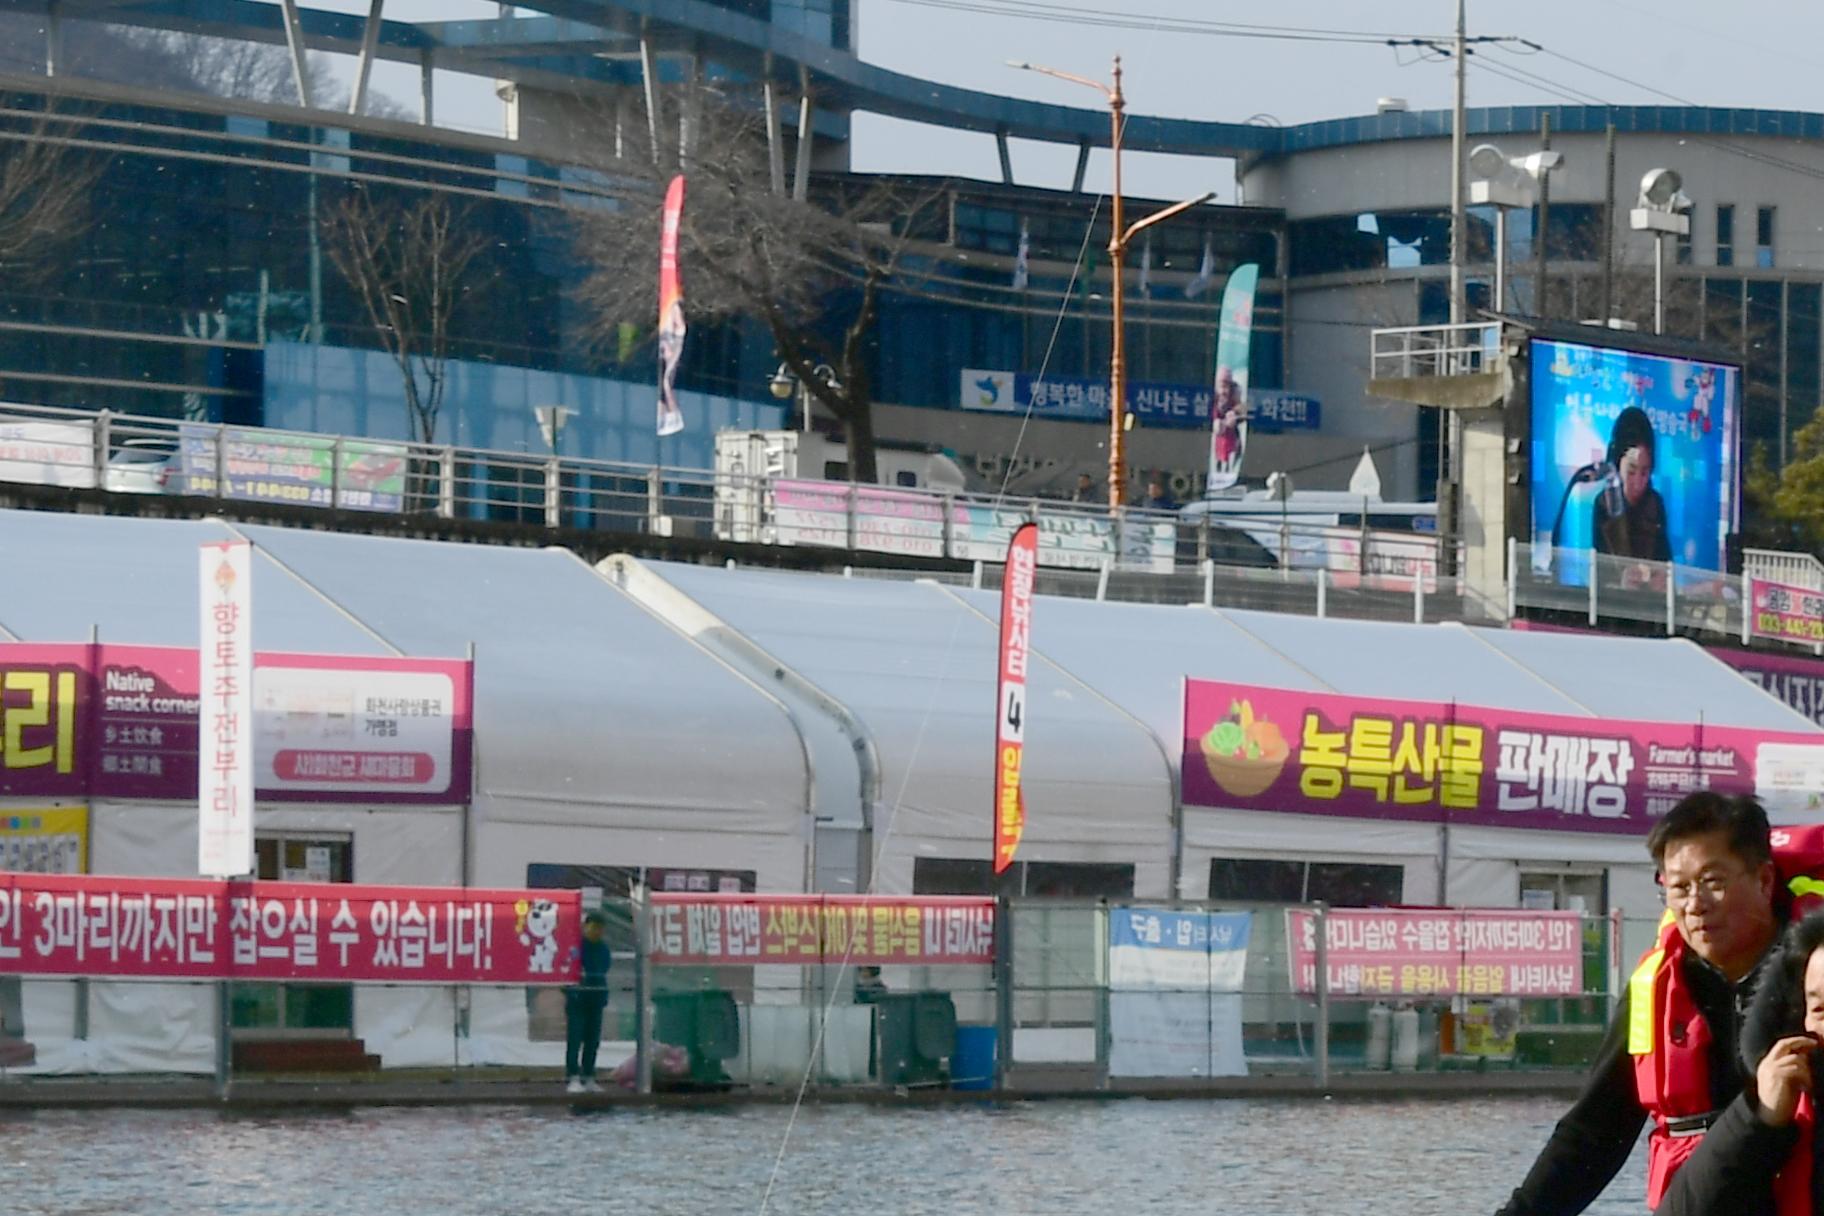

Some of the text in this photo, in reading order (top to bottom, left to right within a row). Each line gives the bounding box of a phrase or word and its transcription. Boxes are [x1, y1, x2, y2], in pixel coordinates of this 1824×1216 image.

[1030, 382, 1083, 407] 행복한
[1136, 389, 1188, 416] 신나는
[105, 669, 155, 692] Native
[0, 671, 76, 774] 리
[105, 694, 150, 712] snack
[211, 602, 240, 817] 향토주전부리
[1006, 692, 1022, 734] 4
[1299, 714, 1634, 818] 농특산물 판매장
[1648, 743, 1697, 765] Farmer's
[35, 889, 217, 964] 3마리까지만
[229, 896, 320, 968] 잡으실
[329, 900, 361, 968] 수
[370, 898, 494, 971] 있습니다!
